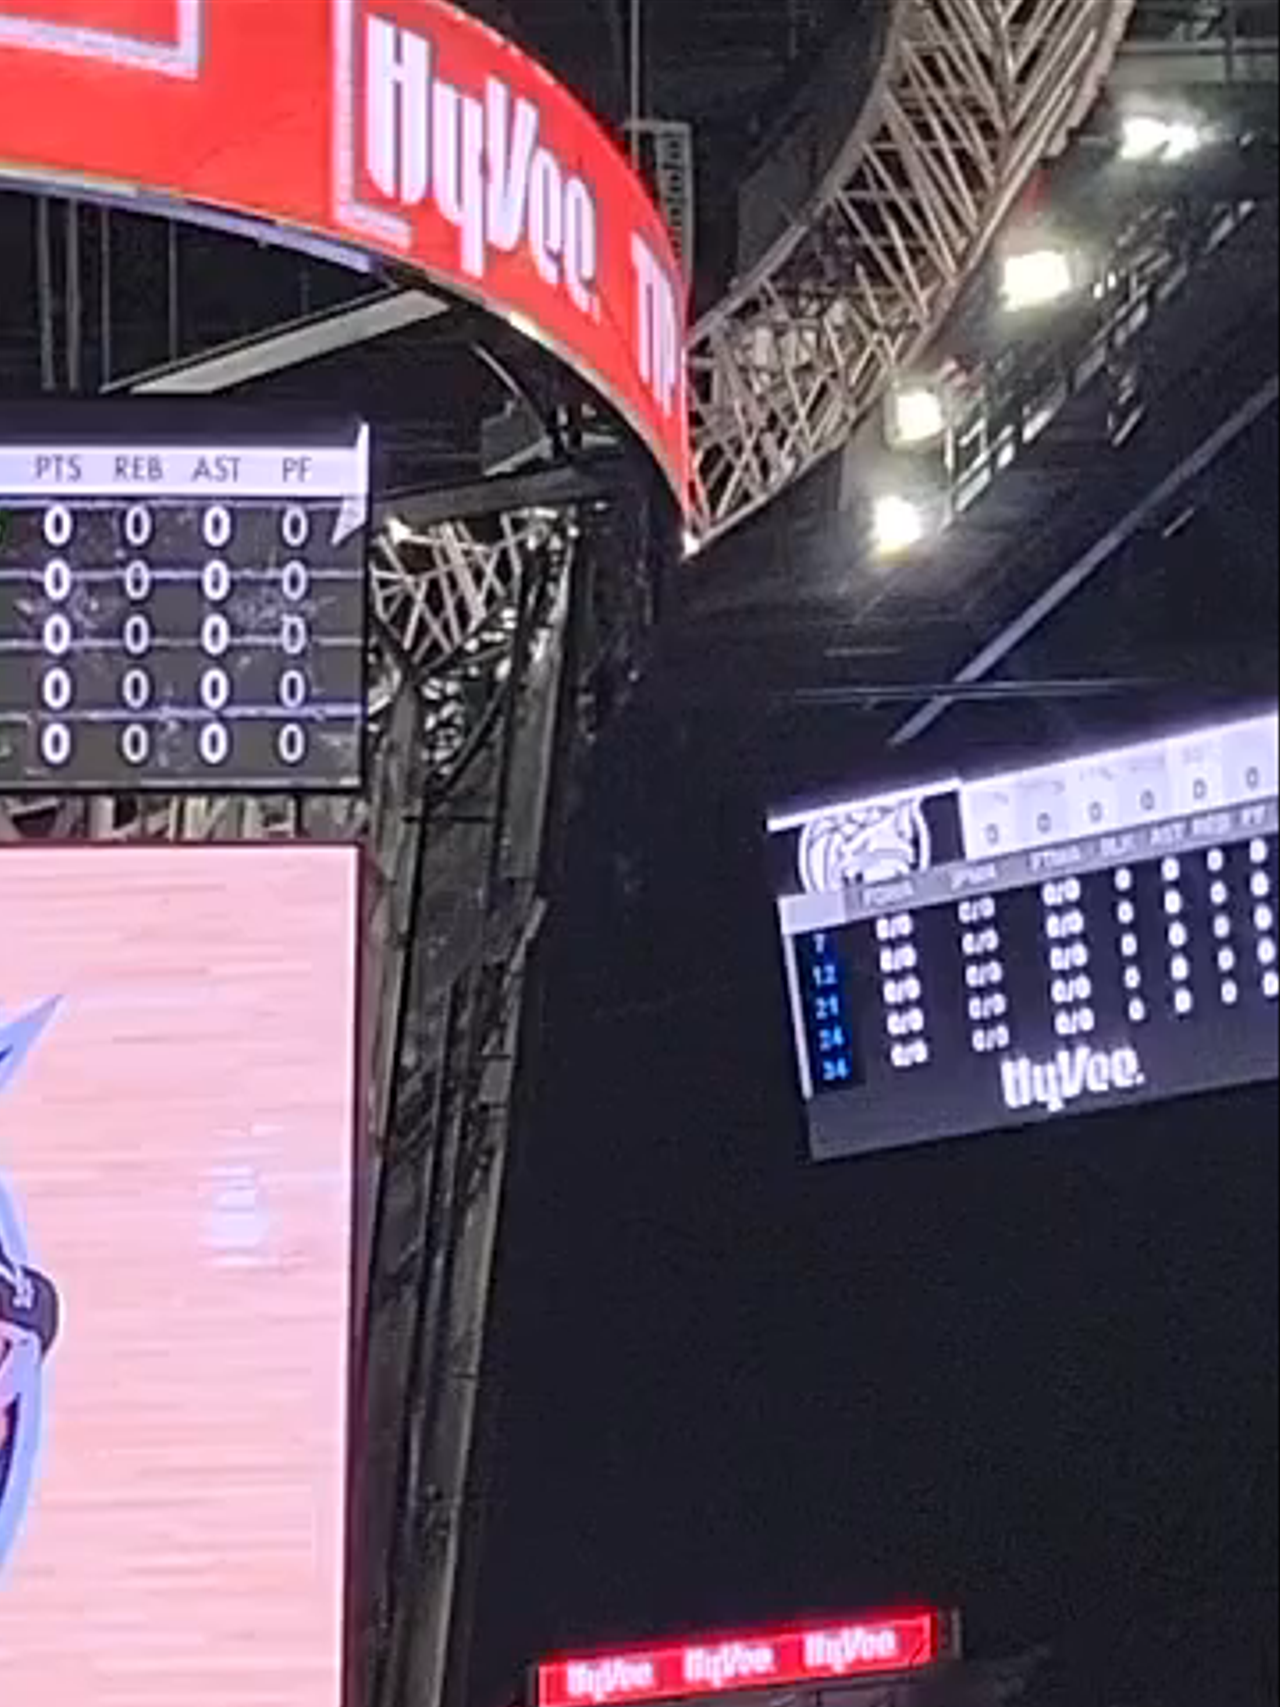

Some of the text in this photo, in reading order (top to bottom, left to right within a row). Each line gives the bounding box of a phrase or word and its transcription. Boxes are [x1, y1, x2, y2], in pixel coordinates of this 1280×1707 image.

[36, 457, 312, 481] PTS REB AST PF
[44, 505, 72, 546] 0
[125, 505, 151, 546] 0
[202, 505, 230, 546] 0
[283, 505, 308, 546] 0
[44, 560, 72, 600] 0
[125, 560, 151, 600] 0
[202, 560, 230, 600] 0
[283, 560, 308, 600] 0
[43, 614, 71, 654] 0
[124, 614, 150, 654] 0
[201, 614, 229, 654] 0
[282, 614, 307, 654] 0
[42, 668, 70, 708] 0
[123, 668, 149, 708] 0
[200, 668, 228, 708] 0
[281, 668, 306, 708] 0
[42, 723, 70, 763] 0
[123, 723, 149, 763] 0
[200, 723, 228, 763] 0
[281, 723, 306, 763] 0
